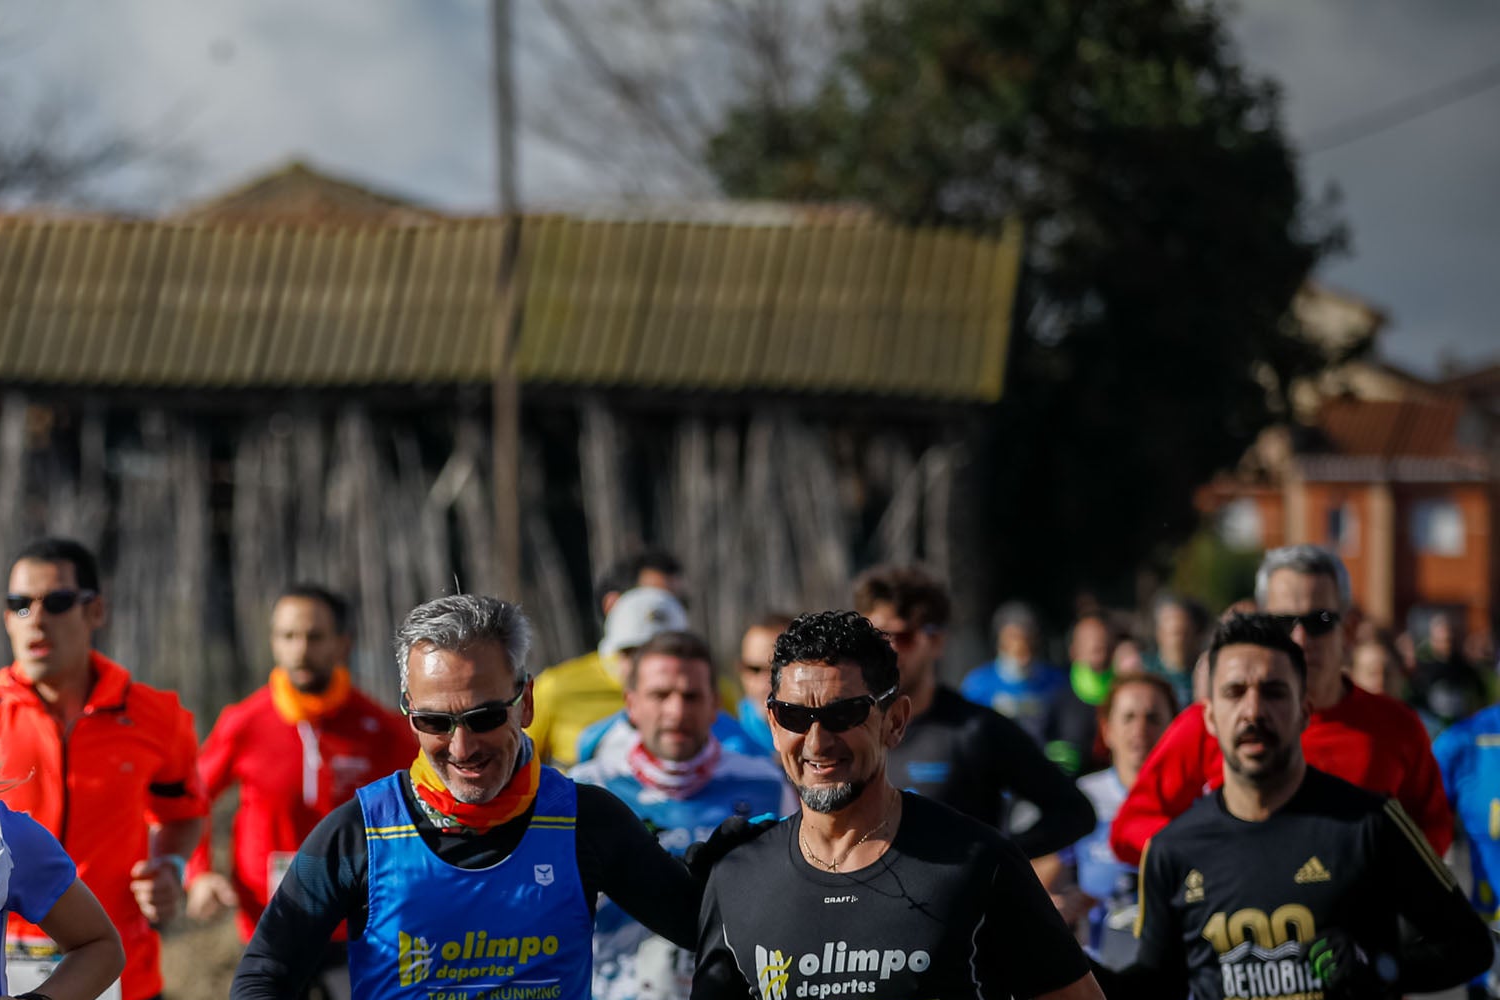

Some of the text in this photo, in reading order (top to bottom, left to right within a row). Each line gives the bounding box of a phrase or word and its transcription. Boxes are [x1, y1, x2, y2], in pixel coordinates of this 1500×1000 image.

[824, 896, 850, 904] CRAFT
[1202, 903, 1316, 956] 100
[441, 930, 559, 964] olimpo
[798, 941, 931, 980] olimpo
[436, 965, 515, 982] deportes
[490, 985, 561, 1000] RUNNING
[796, 979, 876, 999] deportes
